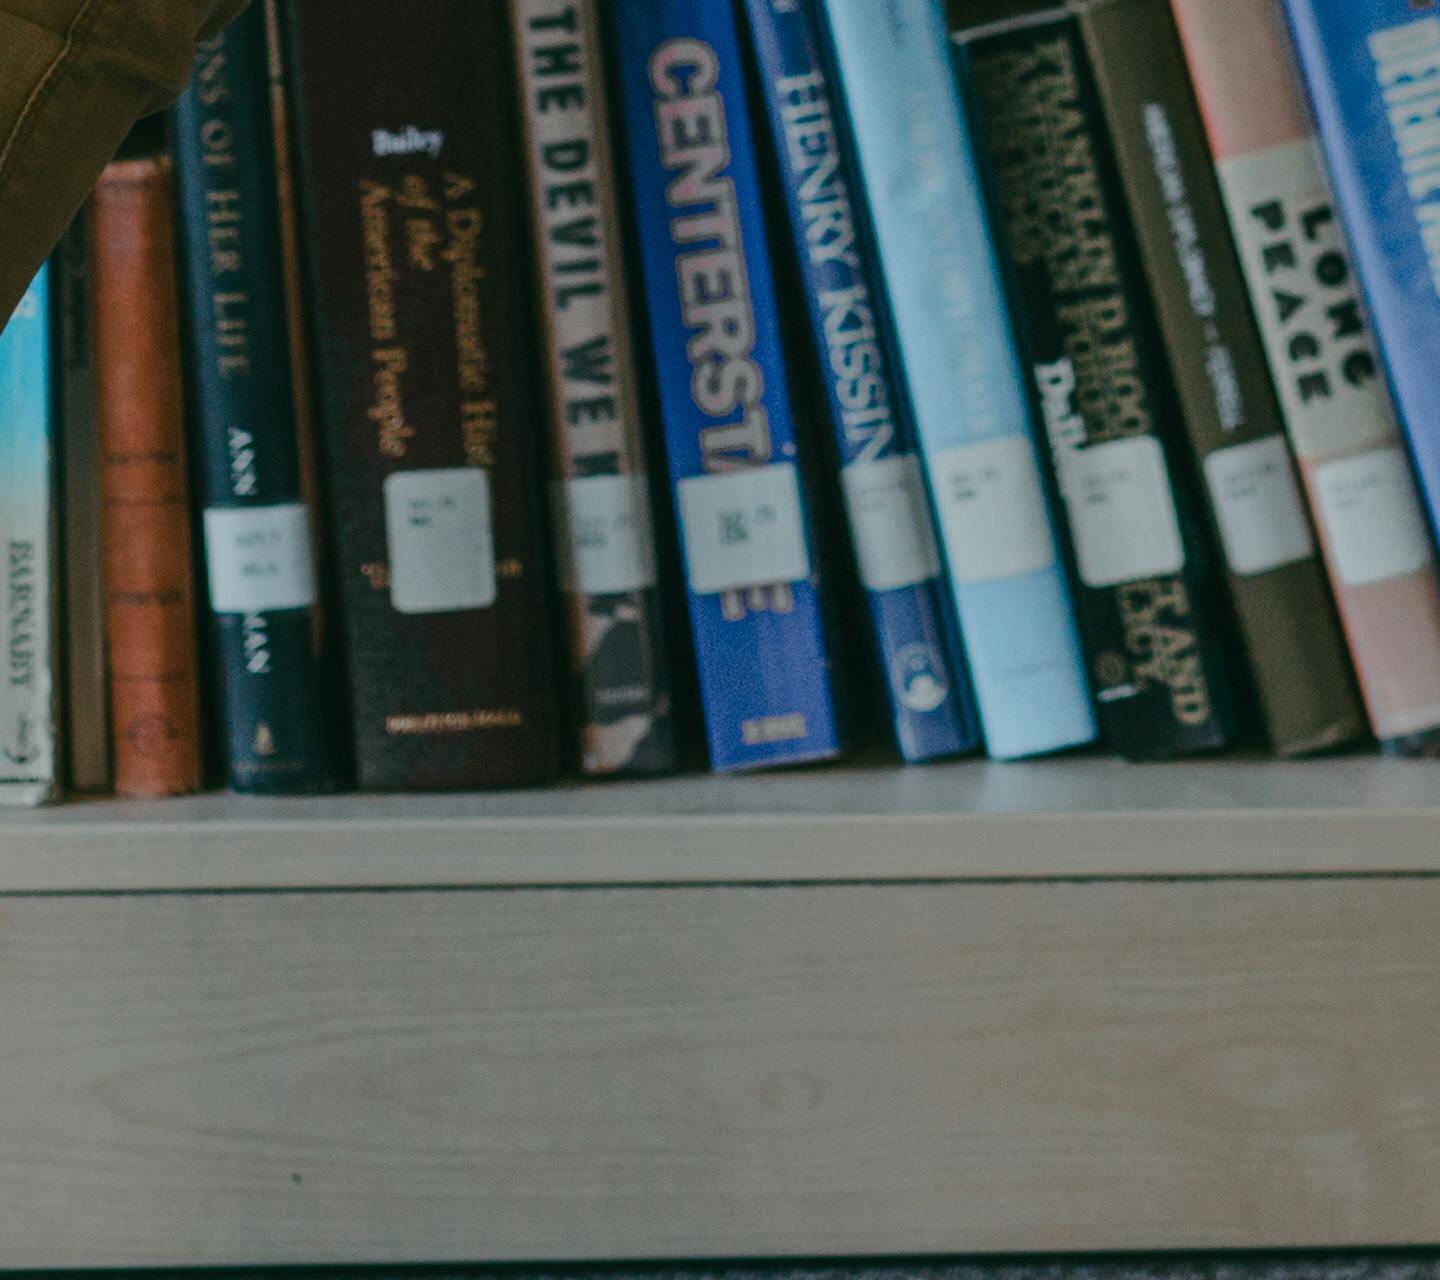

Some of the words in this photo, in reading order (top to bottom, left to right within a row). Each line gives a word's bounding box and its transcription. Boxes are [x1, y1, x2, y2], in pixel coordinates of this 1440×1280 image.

[526, 4, 588, 116] THE
[202, 189, 240, 276] HER
[358, 180, 397, 342] American
[401, 217, 436, 272] the
[438, 205, 494, 392] Diplomatic
[539, 137, 605, 312] DEVIL
[772, 69, 858, 270] HENRY
[816, 283, 896, 470] KISSIN
[1298, 200, 1379, 389] LONG
[212, 292, 252, 380] LIFE
[1250, 198, 1334, 406] PEACE
[366, 345, 414, 459] People
[560, 336, 618, 425] WE
[6, 538, 35, 690] BARNABY
